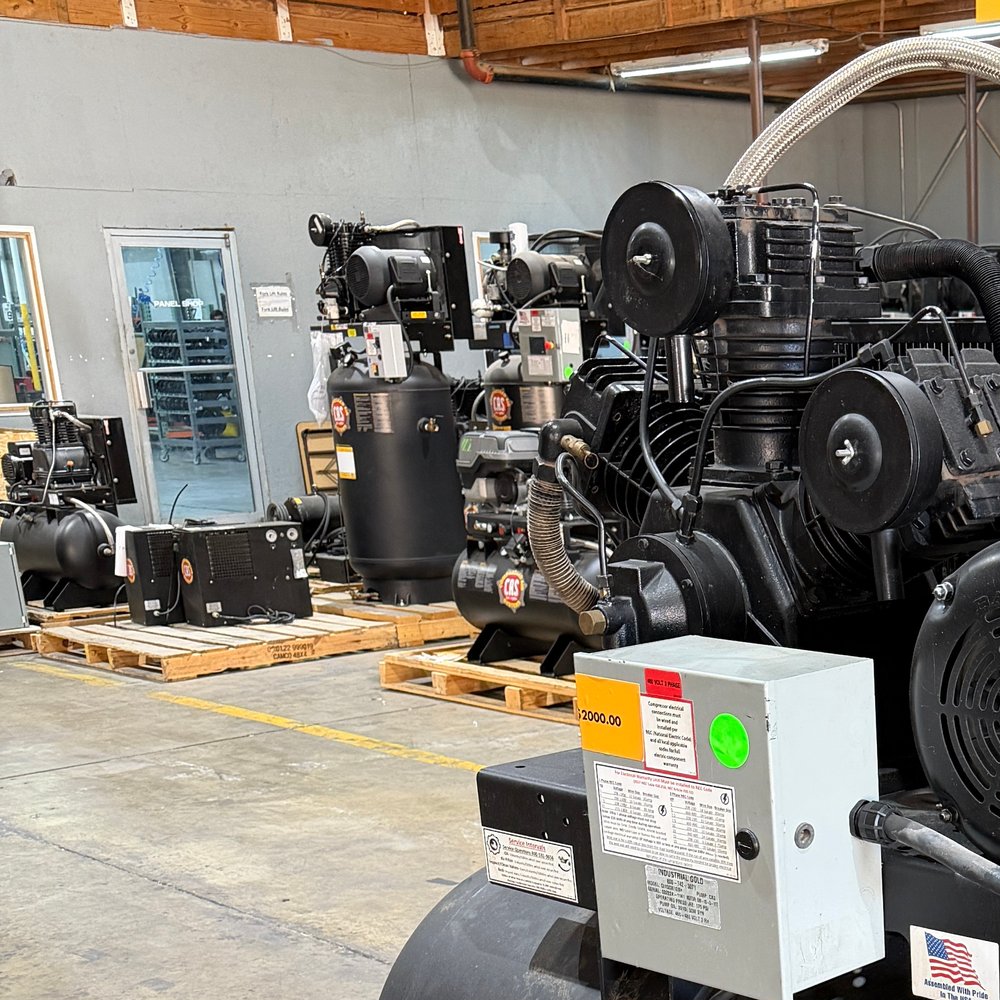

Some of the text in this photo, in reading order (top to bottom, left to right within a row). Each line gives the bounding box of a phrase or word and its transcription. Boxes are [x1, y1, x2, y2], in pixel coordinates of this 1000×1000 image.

[504, 578, 520, 597] CAS
[648, 701, 668, 709] Compressor
[658, 869, 704, 885] INDUSTRIAL GOLD
[924, 979, 989, 1000] Assembled With Pride
[947, 993, 959, 1000] The
